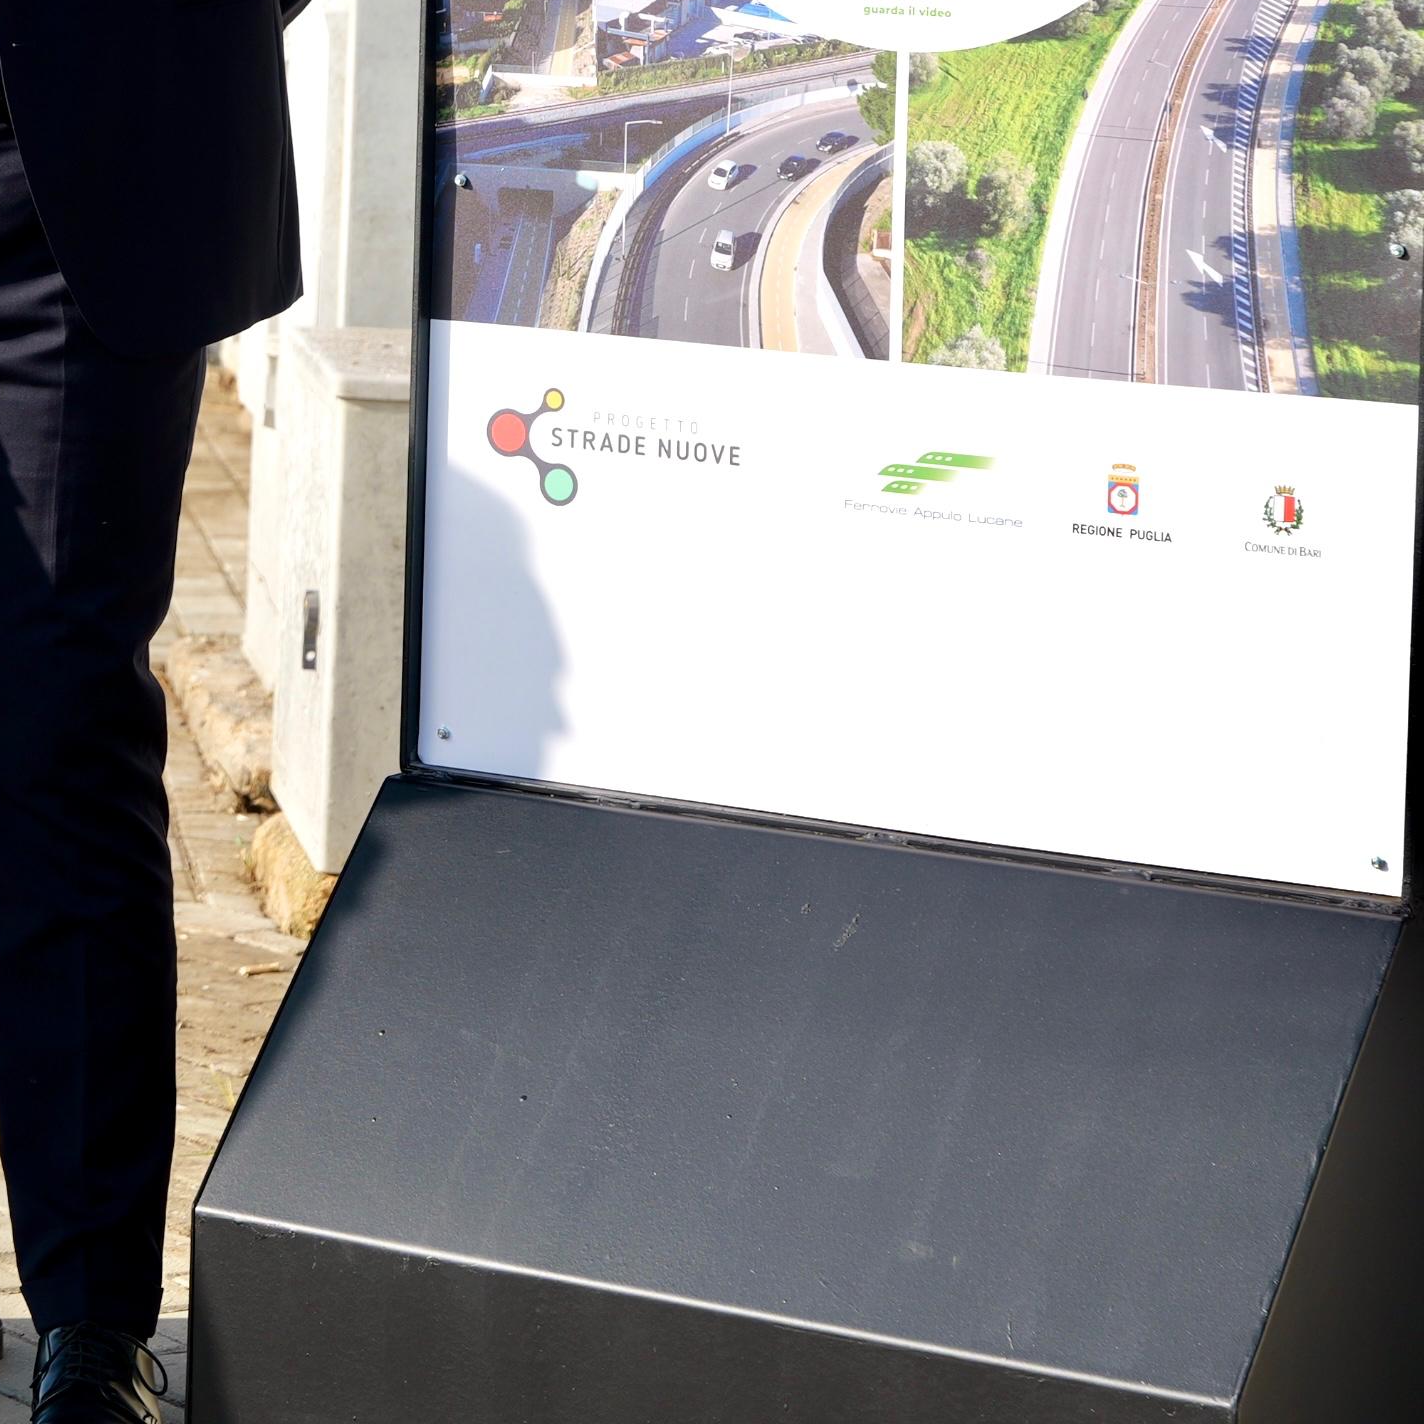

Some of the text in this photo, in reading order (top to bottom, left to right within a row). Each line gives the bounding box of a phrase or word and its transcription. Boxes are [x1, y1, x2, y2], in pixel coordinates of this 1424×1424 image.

[863, 5, 952, 18] guarda il video
[592, 411, 699, 435] PROGETTO
[551, 427, 741, 467] STRADE NUOVE
[844, 499, 1023, 528] Ferrovie Appulo Lucane
[1072, 523, 1172, 543] REGIONE PUGLIA
[1299, 546, 1322, 558] BARI
